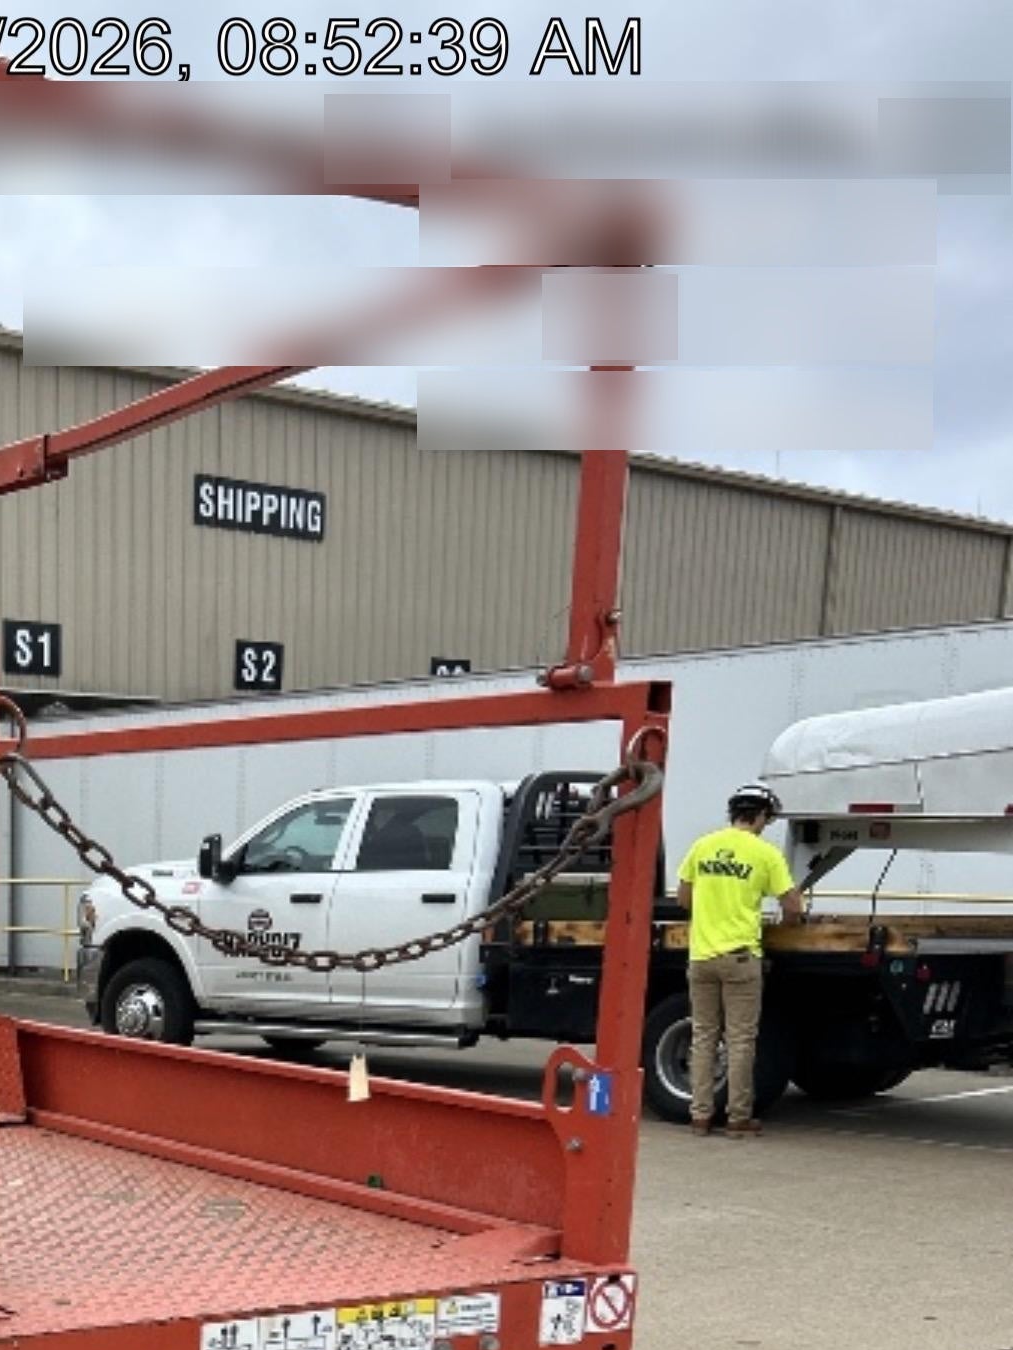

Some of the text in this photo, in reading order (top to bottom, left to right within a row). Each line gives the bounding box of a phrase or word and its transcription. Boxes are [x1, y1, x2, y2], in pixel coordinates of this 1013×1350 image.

[198, 481, 322, 533] SHIPPING
[14, 628, 52, 668] S1
[241, 648, 277, 682] S2
